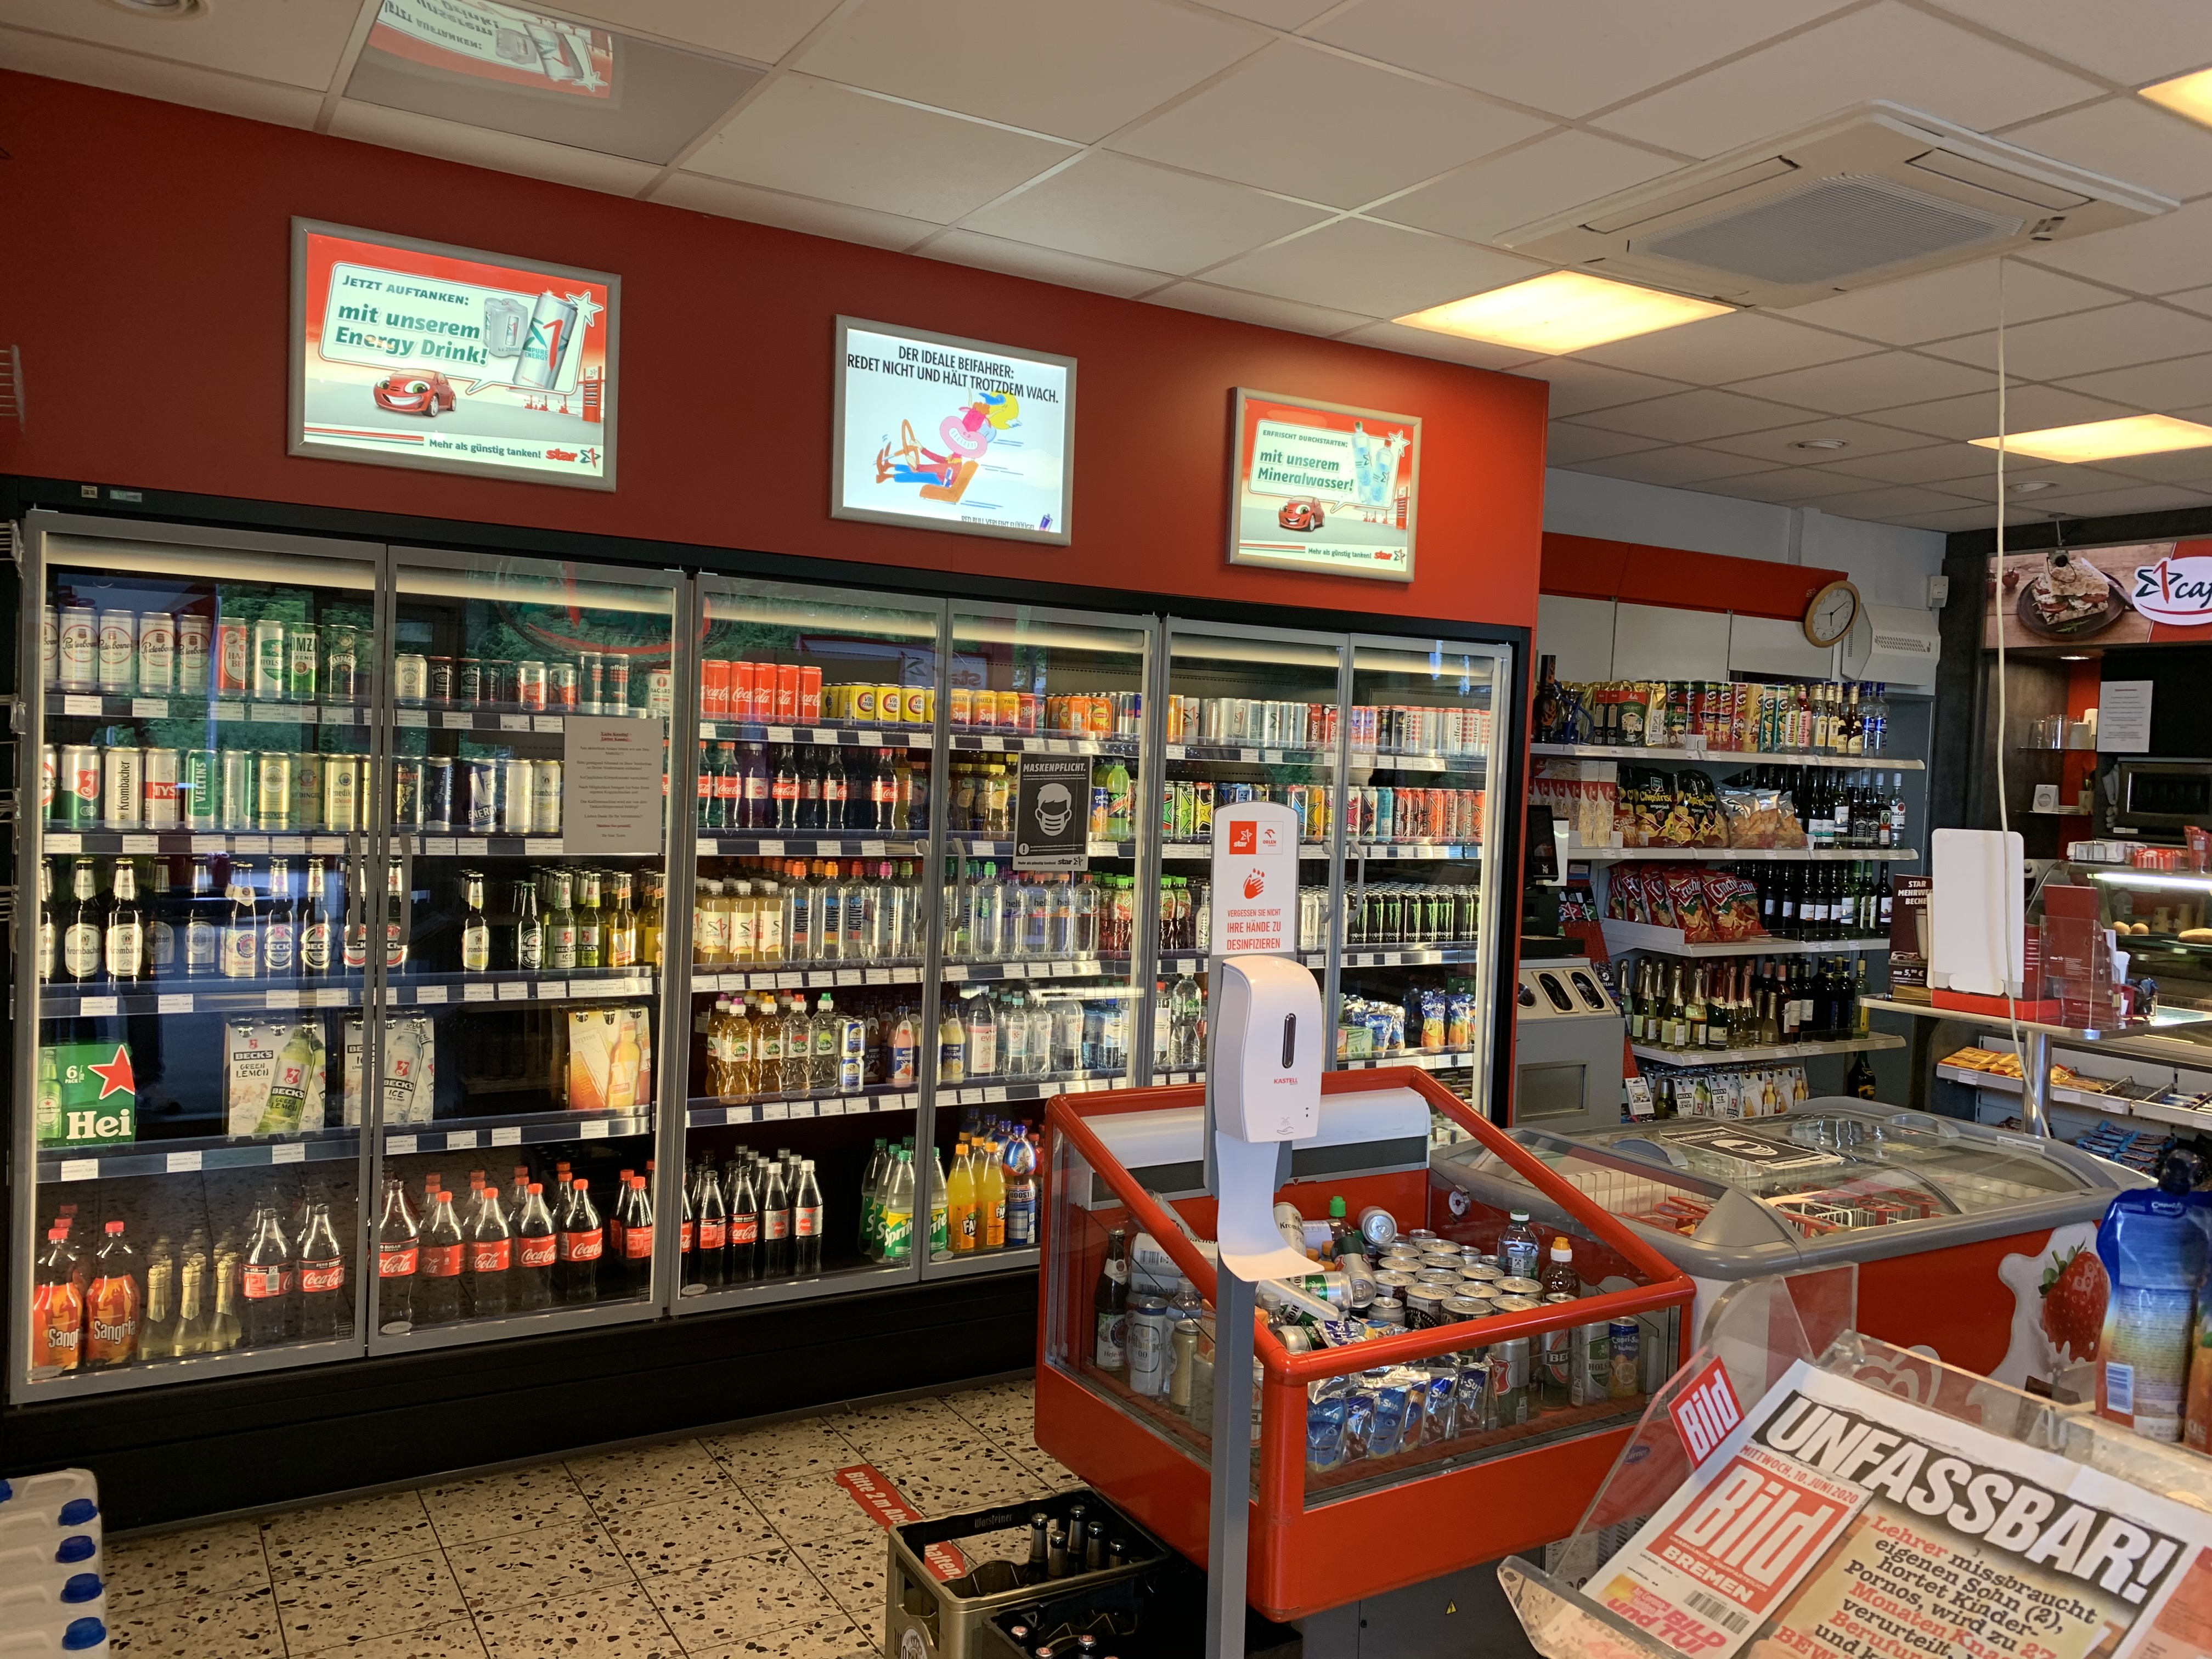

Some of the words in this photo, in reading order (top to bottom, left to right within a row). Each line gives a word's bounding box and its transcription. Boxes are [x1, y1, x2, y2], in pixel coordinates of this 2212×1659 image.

[342, 275, 382, 291] JETZT
[386, 283, 470, 306] AUFTANKEN:
[338, 303, 380, 324] mit
[385, 311, 480, 339] unserem
[335, 326, 413, 356] Energy
[421, 339, 488, 365] Drink!
[532, 347, 548, 356] PURE
[899, 346, 918, 362] DER
[922, 350, 955, 369] IDEALE
[958, 356, 1014, 379] BEIFAHRER:
[848, 354, 879, 372] REDET
[883, 360, 913, 377] NICHT
[917, 366, 940, 383] UND
[943, 370, 968, 387] HÄLT
[970, 375, 1024, 397] TROTZDEM
[1026, 385, 1059, 403] WACH.
[430, 439, 453, 450] Mehr
[455, 442, 467, 452] als
[470, 443, 504, 456] günstig
[506, 447, 541, 459] tanken!
[1263, 430, 1297, 440] ERFRISCHT
[1299, 435, 1348, 448] DURCHSTARTEN:
[545, 448, 578, 462] star
[1260, 450, 1283, 464] mit
[1287, 454, 1339, 471] unserem
[1257, 467, 1354, 492] Mineralwasser!
[1331, 550, 1351, 559] günstig
[1374, 550, 1392, 560] star
[1023, 763, 1086, 772] MASKENPFLICHT.
[117, 761, 131, 811] Krombacher
[195, 762, 207, 803] VELTINS
[468, 805, 496, 819] ENERGY
[826, 905, 839, 933] ACTIVE
[848, 903, 862, 931] ACTIVE
[1227, 922, 1244, 933] IHRE
[1246, 919, 1269, 933] HÄNDE
[1272, 921, 1281, 932] ZU
[1228, 909, 1256, 917] VERGESSEN
[1227, 938, 1280, 950] DESINFIZIEREN
[234, 1051, 273, 1060] BECK'S
[66, 1065, 78, 1079] 6
[236, 1068, 269, 1078] LEMON
[384, 1078, 414, 1091] BECK'S
[270, 1102, 298, 1111] LEMON
[272, 1087, 304, 1099] BECK'S
[388, 1090, 404, 1098] ICE
[93, 1315, 136, 1345] Sangria
[1677, 1368, 1740, 1463] Bild
[844, 1471, 876, 1492] Bitte
[1740, 1444, 1793, 1480] MITTWOCH,
[1793, 1469, 1807, 1486] 10.
[1808, 1475, 1834, 1496] JUNI
[1833, 1484, 1859, 1505] 2020
[1766, 1397, 2178, 1605] UNFASSBAR!
[974, 1513, 1013, 1530] Warsteiner
[1674, 1464, 1836, 1587] Bild
[1662, 1545, 1754, 1604] BREMEN
[1870, 1516, 1949, 1558] Lehrer
[1948, 1553, 2098, 1624] missbraucht
[1875, 1539, 1959, 1585] eigenen
[1962, 1577, 2021, 1614] Sohn
[2024, 1606, 2063, 1635] (2),
[1876, 1556, 1949, 1599] hortet
[1948, 1590, 2039, 1637] Kinder-
[1606, 1598, 1660, 1632] und
[1844, 1559, 1924, 1612] Pornos,
[1931, 1602, 1988, 1636] wird
[1986, 1629, 2018, 1652] zu
[1848, 1581, 1947, 1639] Monaten
[1657, 1623, 1705, 1655] TUI
[1663, 1609, 1727, 1648] BILD
[1815, 1624, 1860, 1655] und
